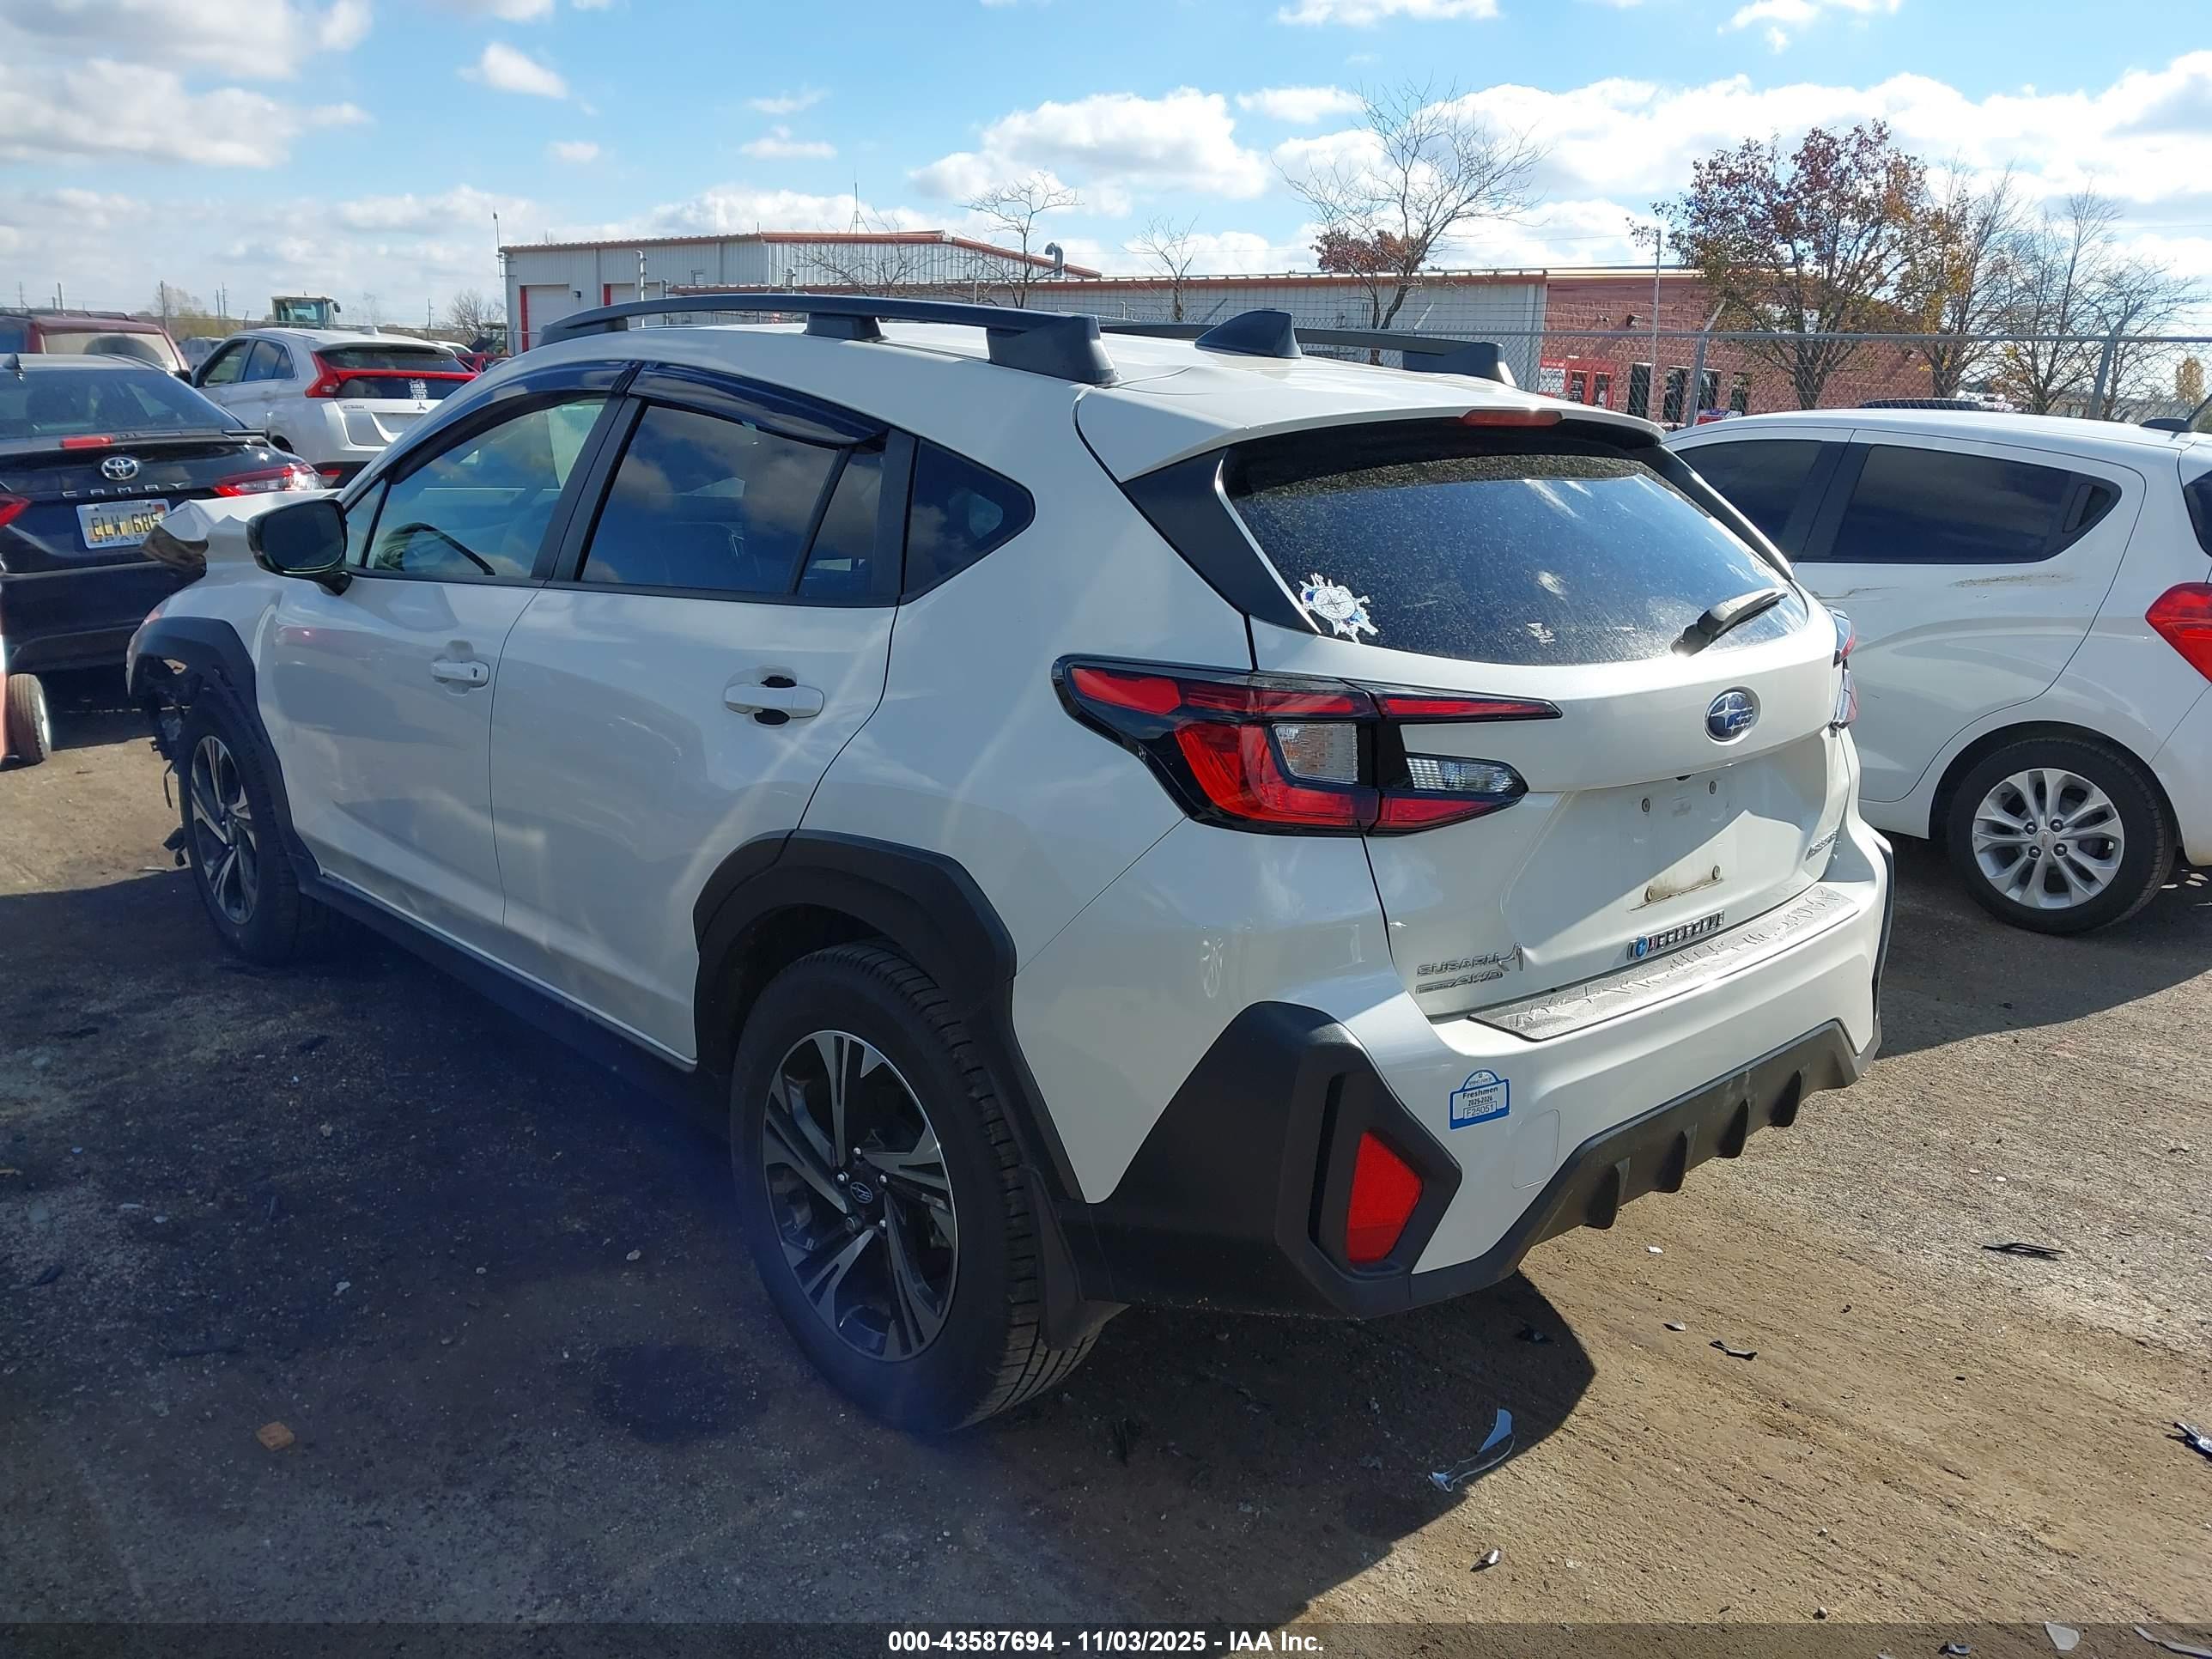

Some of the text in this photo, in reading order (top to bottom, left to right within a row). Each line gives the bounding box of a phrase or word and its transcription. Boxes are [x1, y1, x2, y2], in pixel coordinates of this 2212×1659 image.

[62, 482, 185, 498] CAMRY
[1417, 952, 1499, 976] SUBARU
[1462, 1086, 1498, 1100] Freshmen
